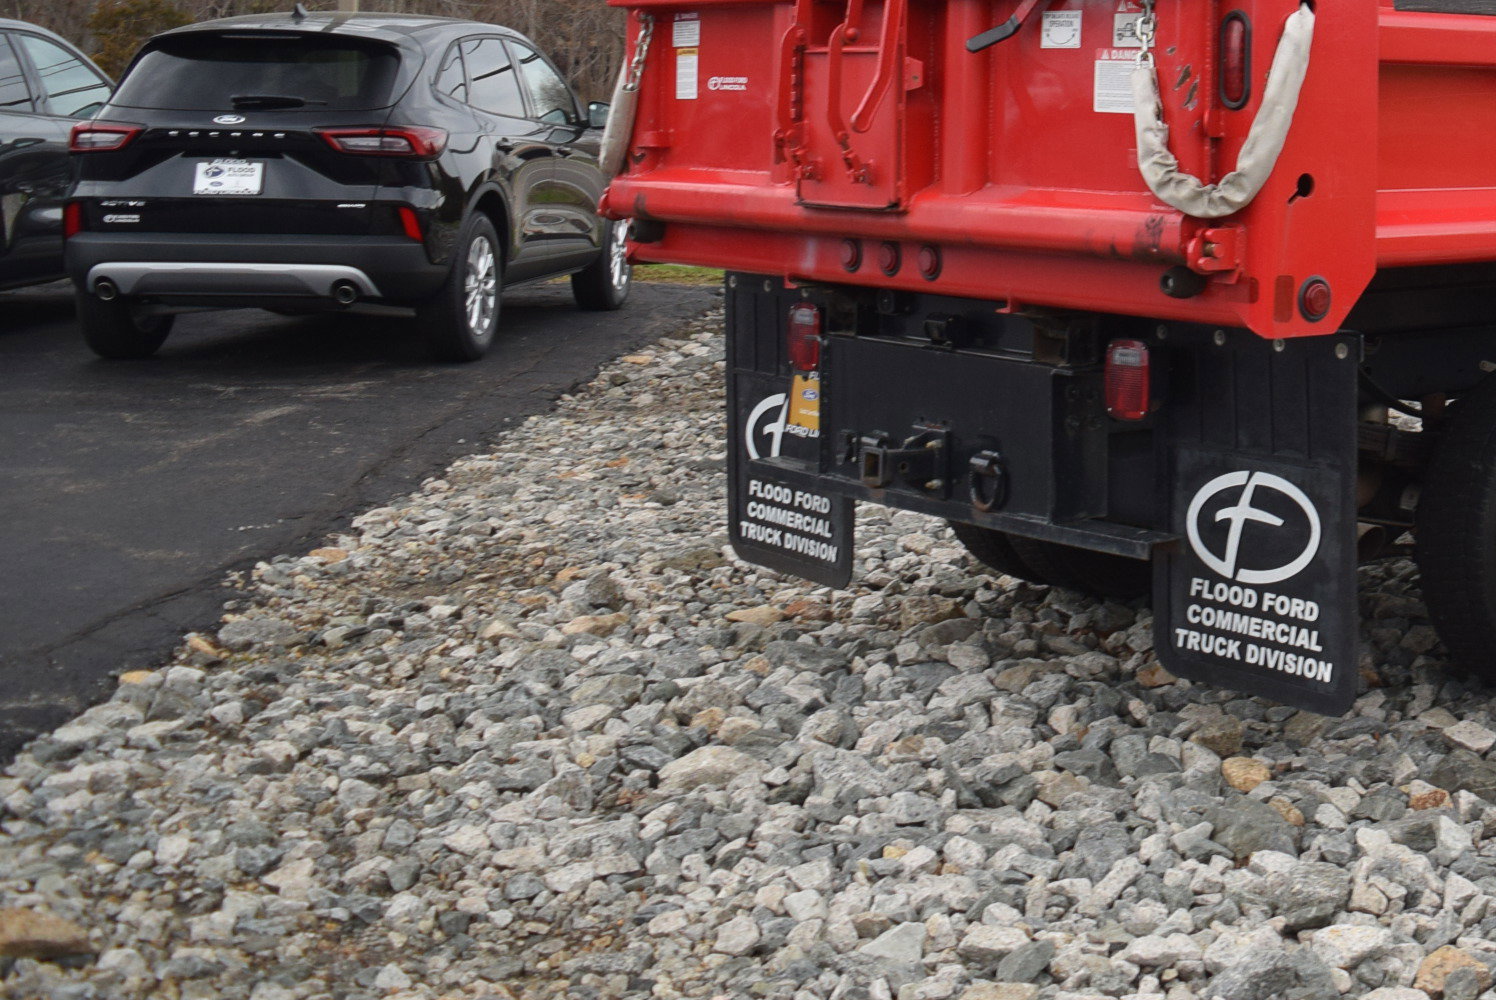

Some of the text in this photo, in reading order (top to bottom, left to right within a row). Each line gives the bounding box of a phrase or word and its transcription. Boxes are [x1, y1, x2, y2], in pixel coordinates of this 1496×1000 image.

[749, 480, 830, 514] FLOOD FORD
[747, 501, 832, 538] COMMERCIAL
[740, 521, 838, 563] TRUCK DIVISION
[1190, 577, 1319, 621] FLOOD FORD
[1187, 604, 1322, 651] COMMERCIAL
[1175, 628, 1333, 682] TRUCK DIVISION
